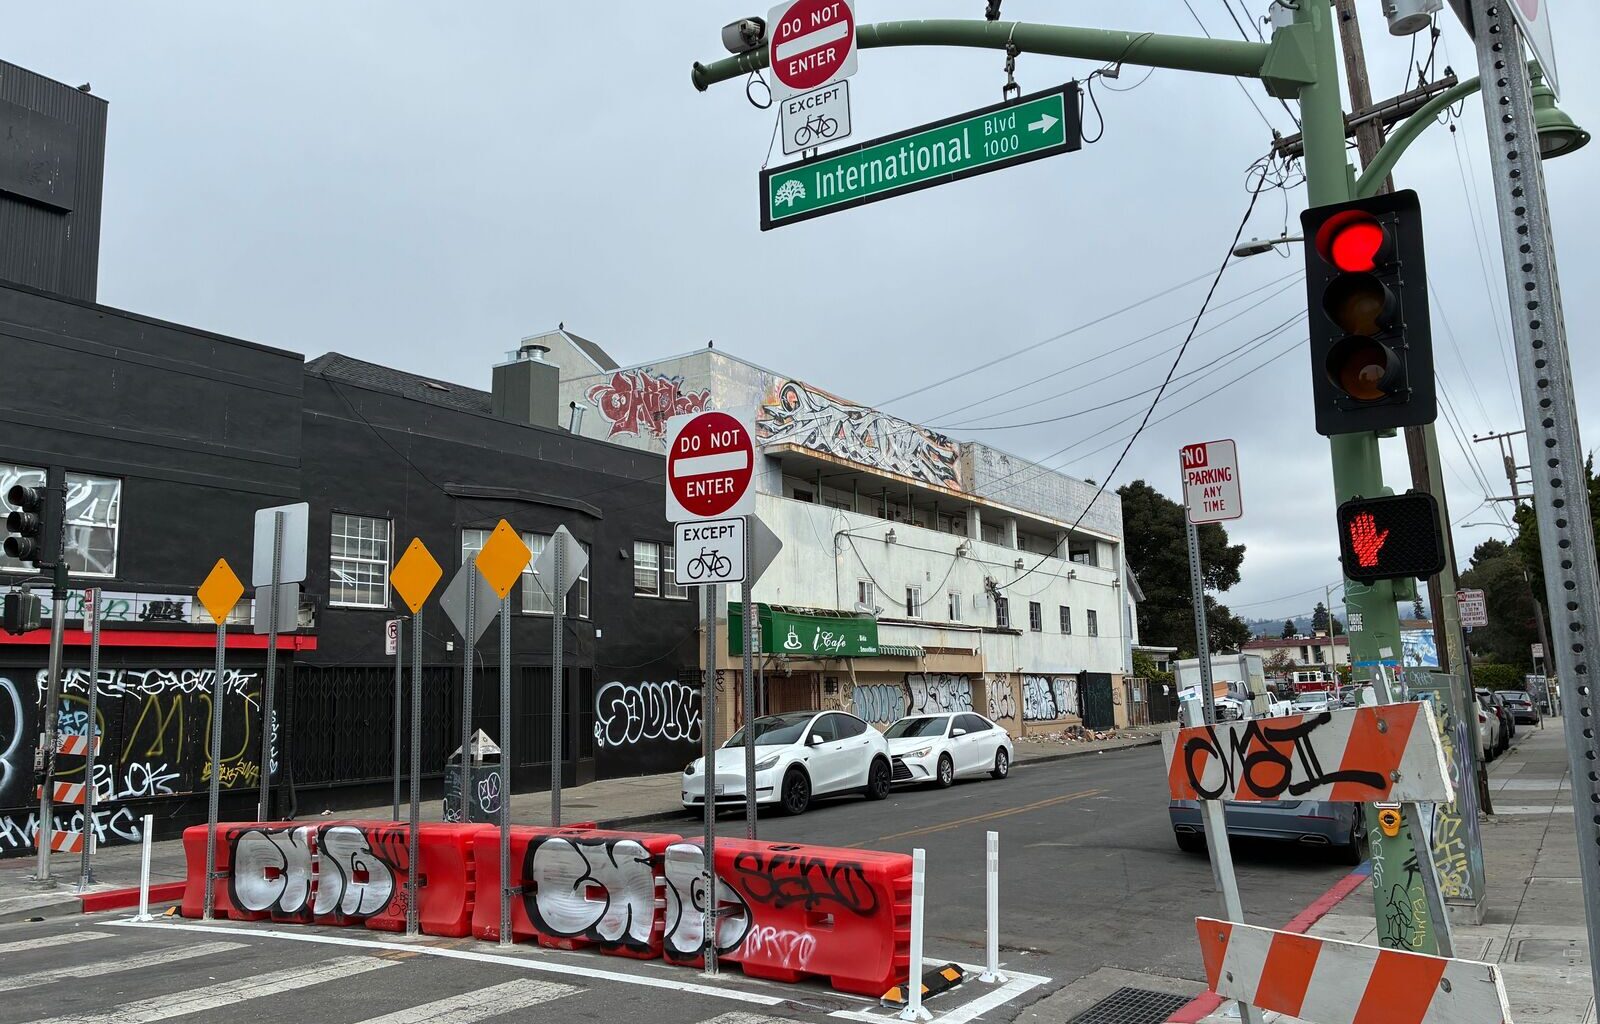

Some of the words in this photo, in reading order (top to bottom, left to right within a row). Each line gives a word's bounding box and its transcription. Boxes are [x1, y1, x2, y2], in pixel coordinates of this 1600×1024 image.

[782, 18, 802, 38] DO
[811, 3, 840, 27] NOT
[789, 47, 836, 76] ENTER
[789, 88, 840, 115] EXCEPT
[815, 127, 972, 199] International
[984, 112, 1016, 136] Blvd
[983, 134, 1019, 158] 1000
[680, 435, 701, 453] DO
[710, 429, 740, 449] NOT
[1185, 447, 1204, 466] NO
[1188, 466, 1232, 486] PARKING
[686, 477, 735, 498] ENTER
[1203, 485, 1222, 499] ANY
[1203, 499, 1226, 513] TIME
[683, 525, 736, 541] EXCEPT
[821, 631, 847, 652] Cafe
